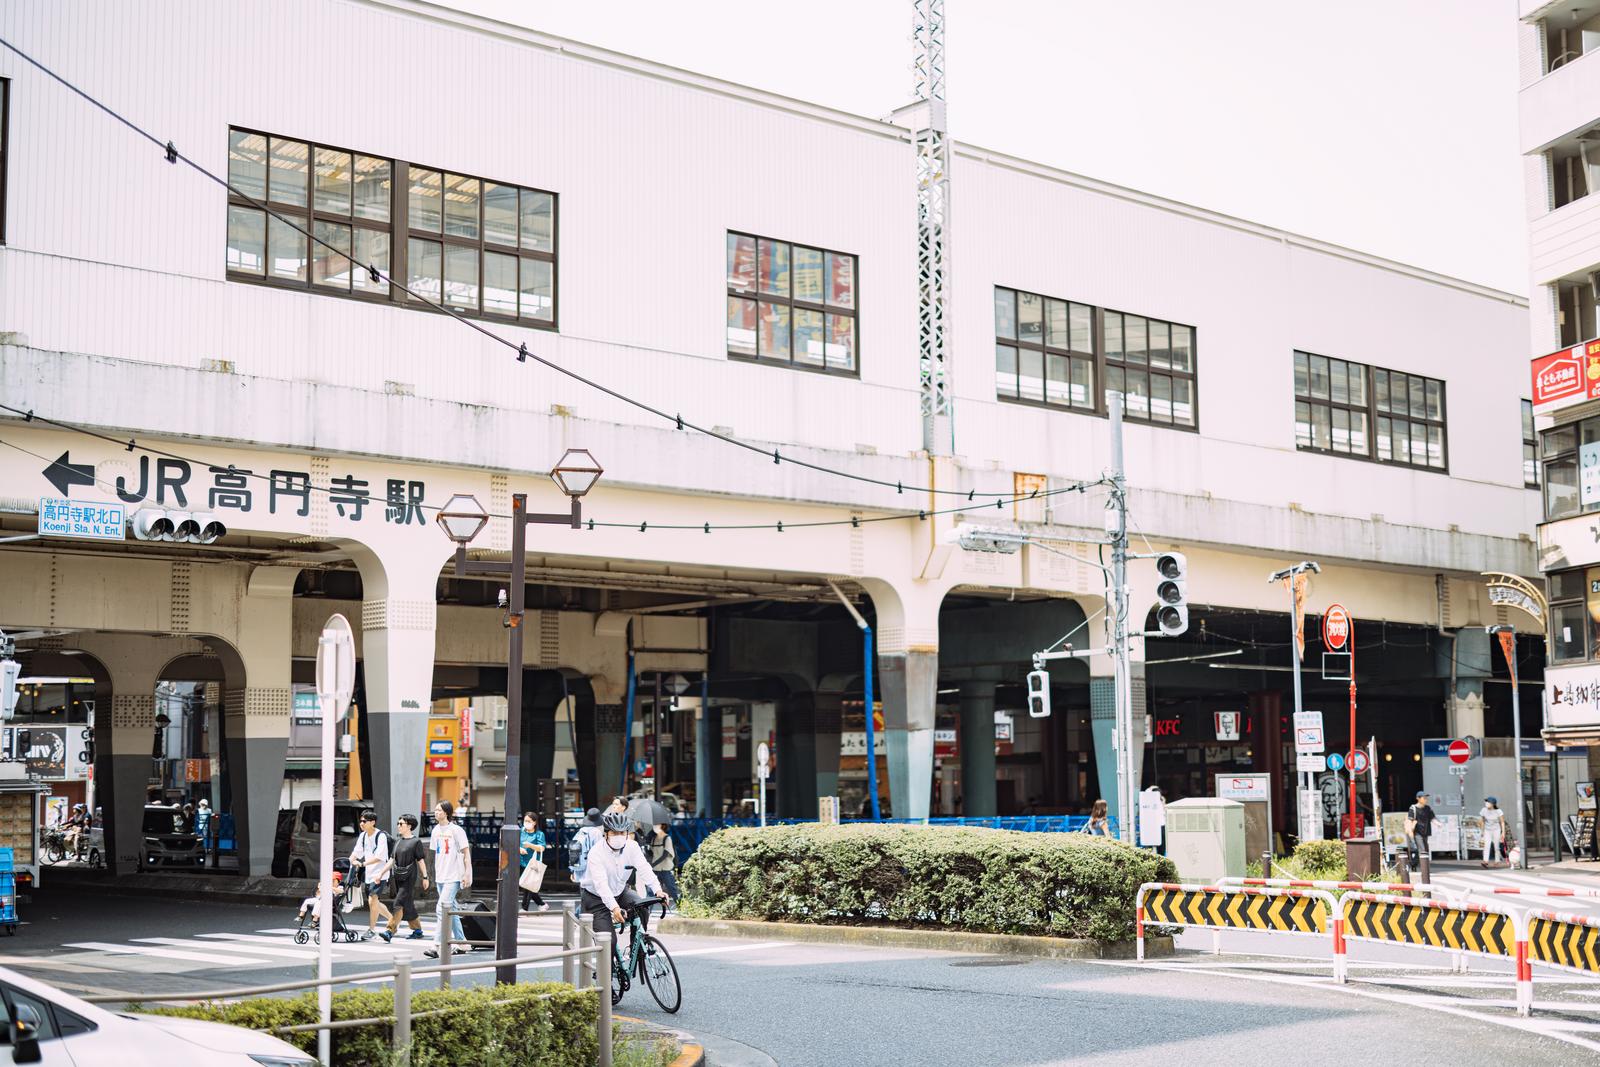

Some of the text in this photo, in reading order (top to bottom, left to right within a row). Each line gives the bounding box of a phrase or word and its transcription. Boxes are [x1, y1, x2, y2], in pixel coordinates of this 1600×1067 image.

[44, 504, 121, 525] 高円寺駅北口
[43, 522, 71, 533] Koenji
[93, 525, 102, 535] N.
[104, 526, 121, 537] Ent.
[1156, 719, 1181, 736] KFC
